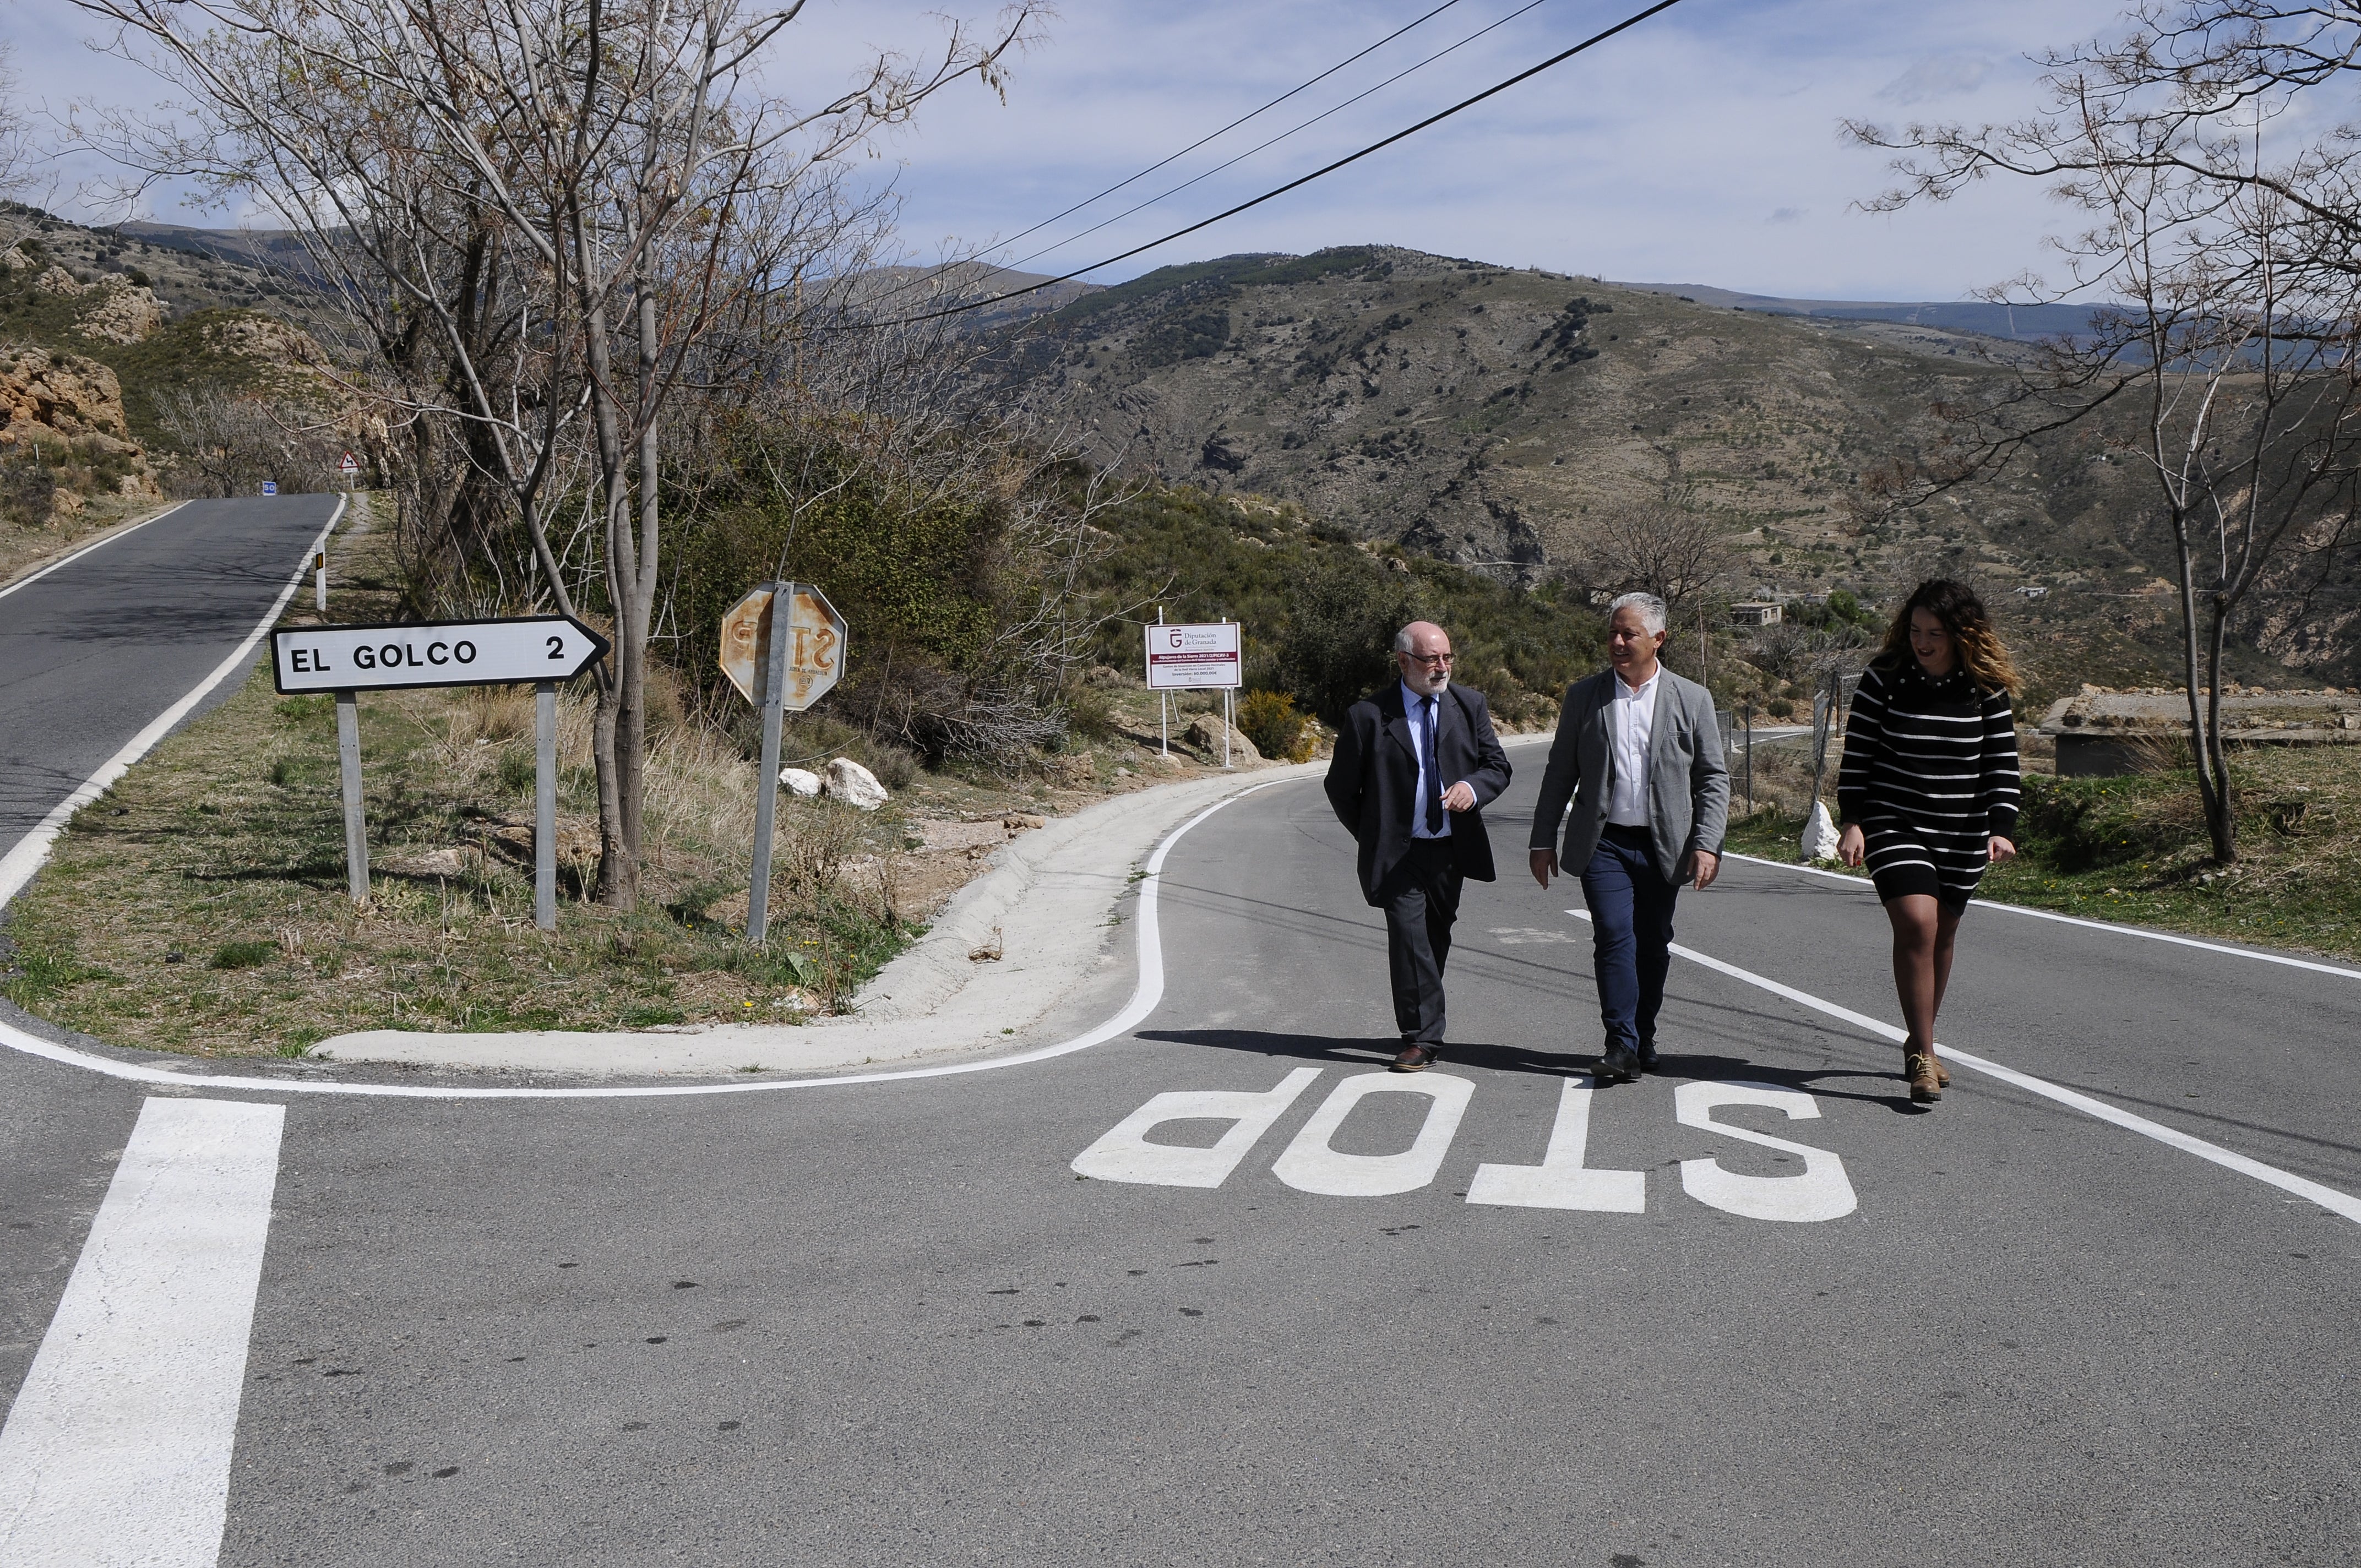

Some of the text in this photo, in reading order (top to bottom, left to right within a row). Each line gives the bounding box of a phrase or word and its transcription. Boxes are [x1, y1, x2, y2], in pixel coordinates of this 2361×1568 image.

[290, 635, 565, 672] EL GOLCO 2
[1070, 1067, 1858, 1222] STOP
